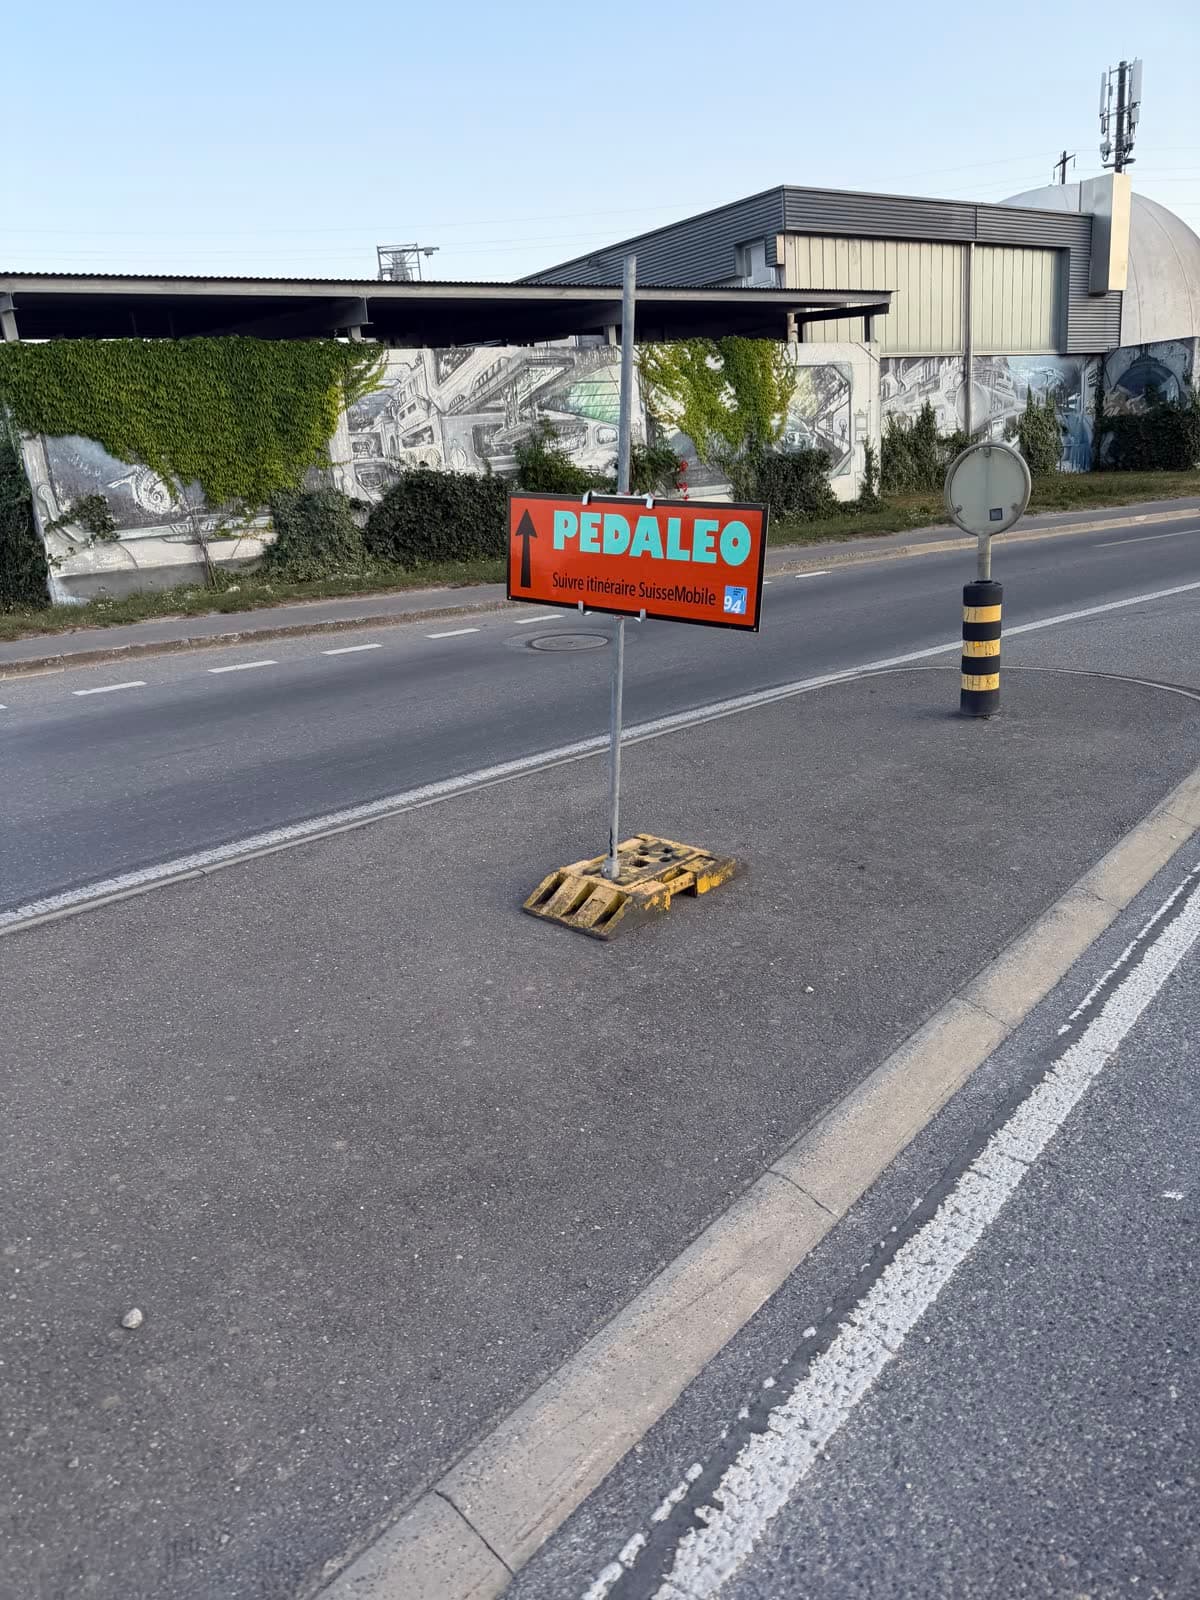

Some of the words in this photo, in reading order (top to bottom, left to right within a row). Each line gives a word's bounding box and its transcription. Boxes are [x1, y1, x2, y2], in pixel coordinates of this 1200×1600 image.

[553, 510, 751, 566] PEDALEO
[552, 571, 584, 590] Suivre
[586, 576, 636, 596] itinéraire
[639, 582, 716, 605] SuisseMobile
[724, 595, 742, 612] 94
